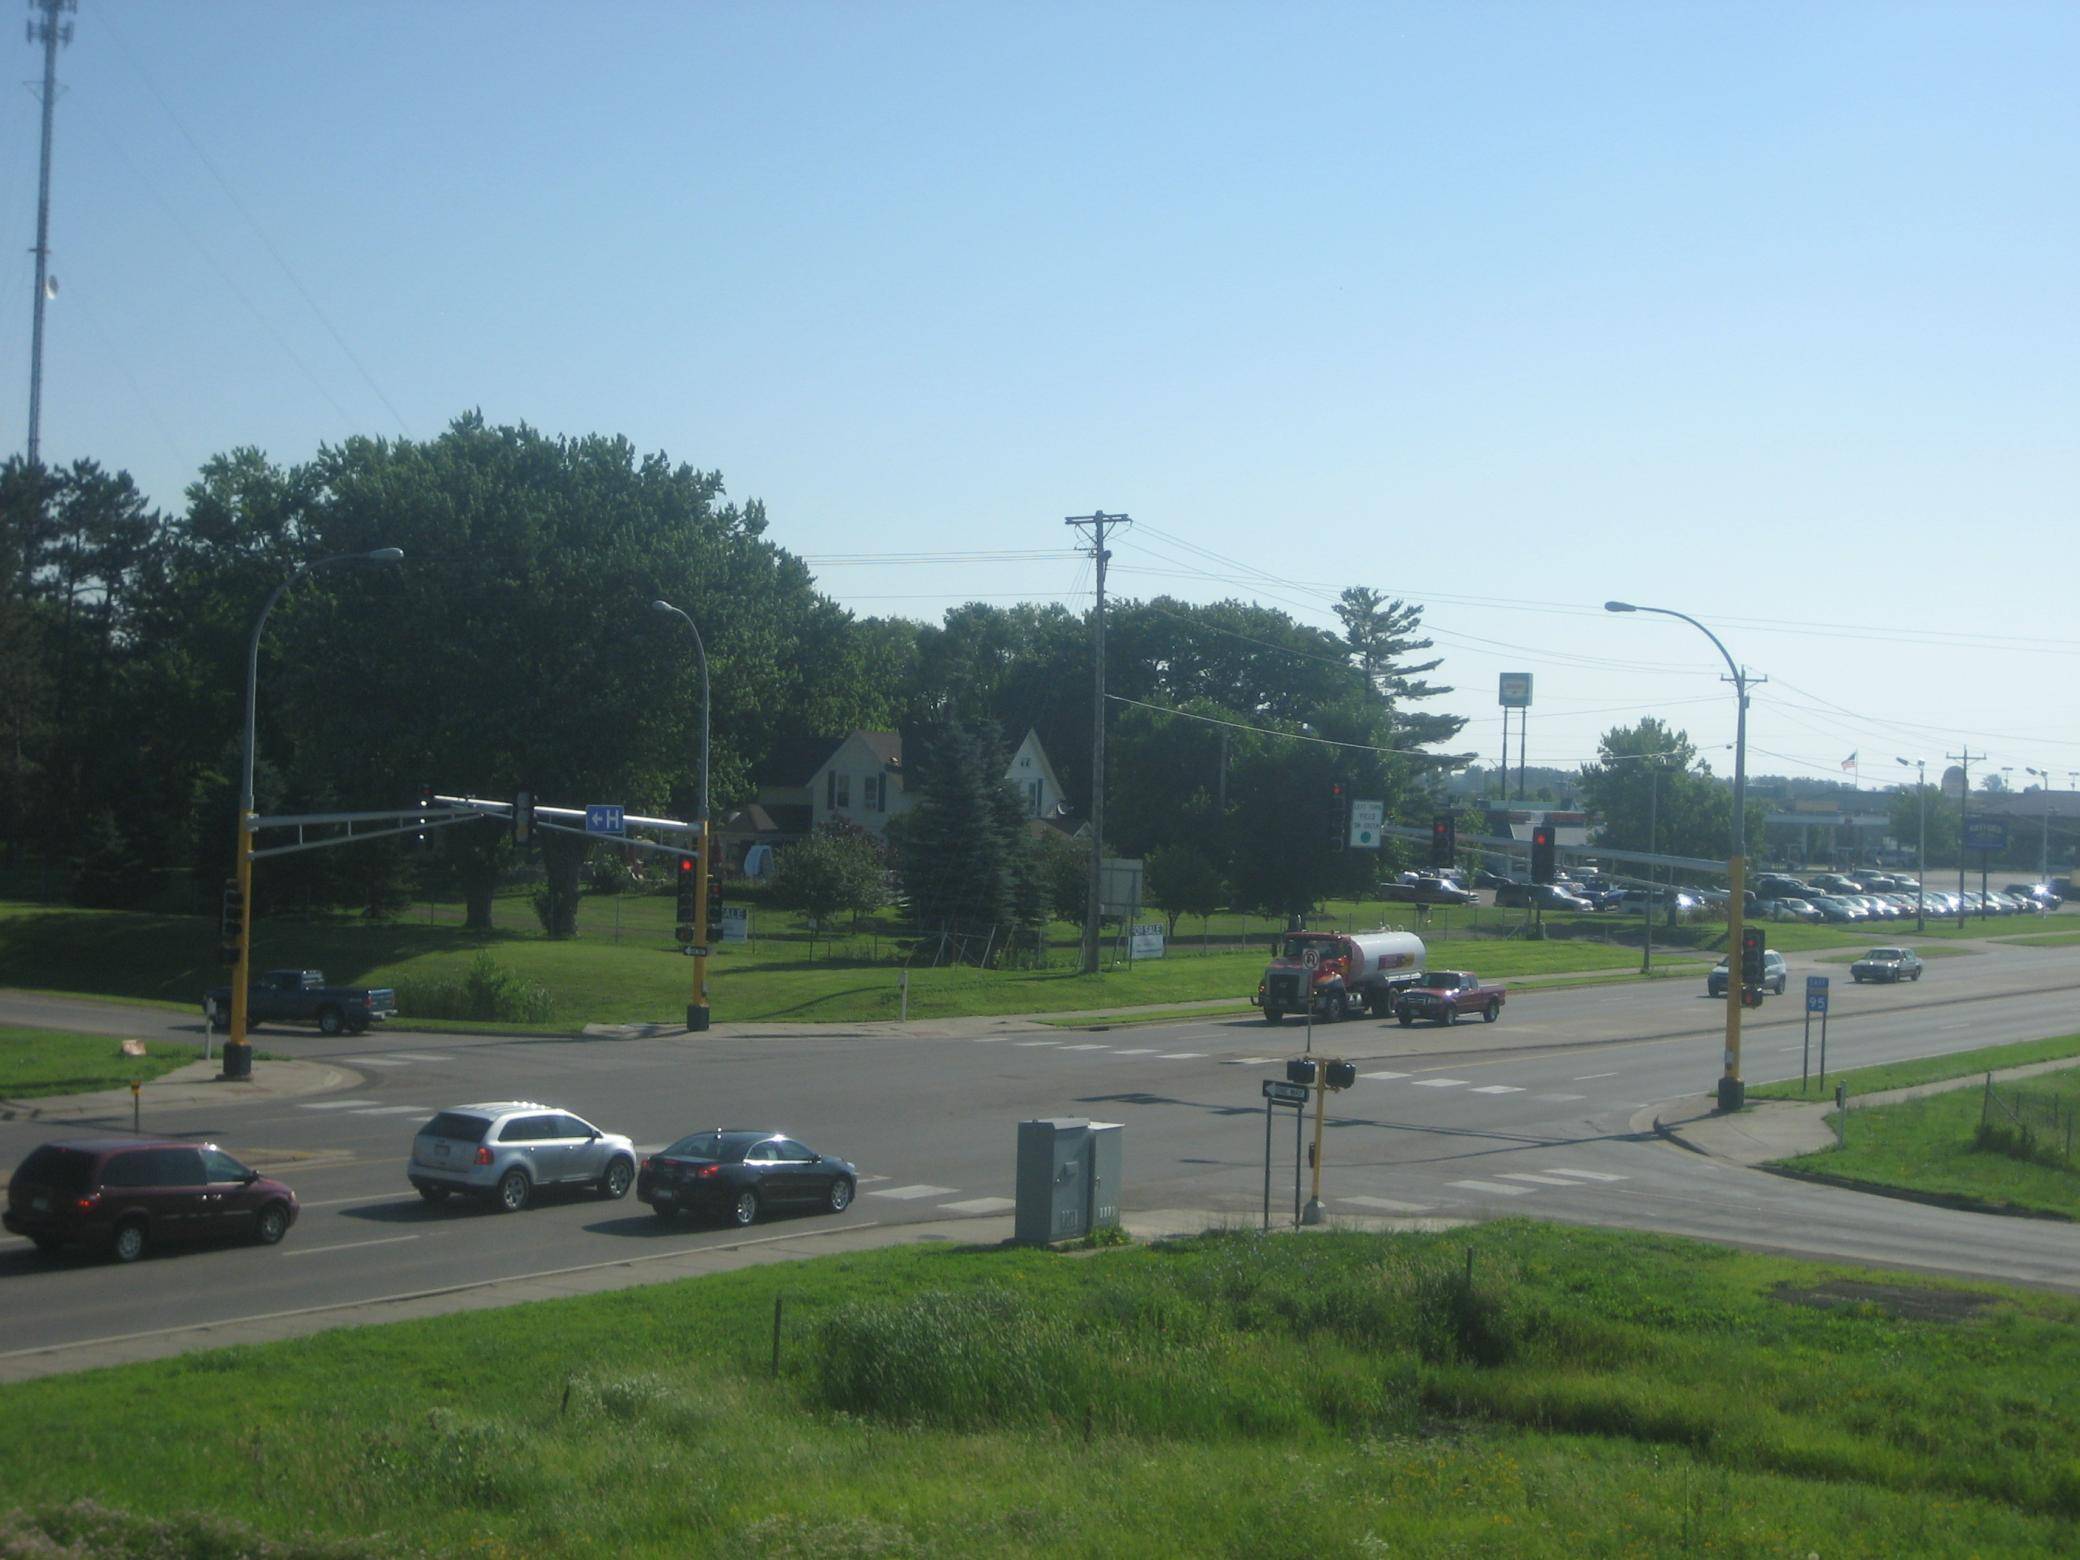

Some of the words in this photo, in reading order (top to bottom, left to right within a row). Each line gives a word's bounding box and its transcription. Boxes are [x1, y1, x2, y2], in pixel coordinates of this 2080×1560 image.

[606, 809, 619, 829] H
[722, 907, 745, 920] ALE
[1144, 924, 1162, 936] SALE
[1809, 996, 1825, 1008] 95
